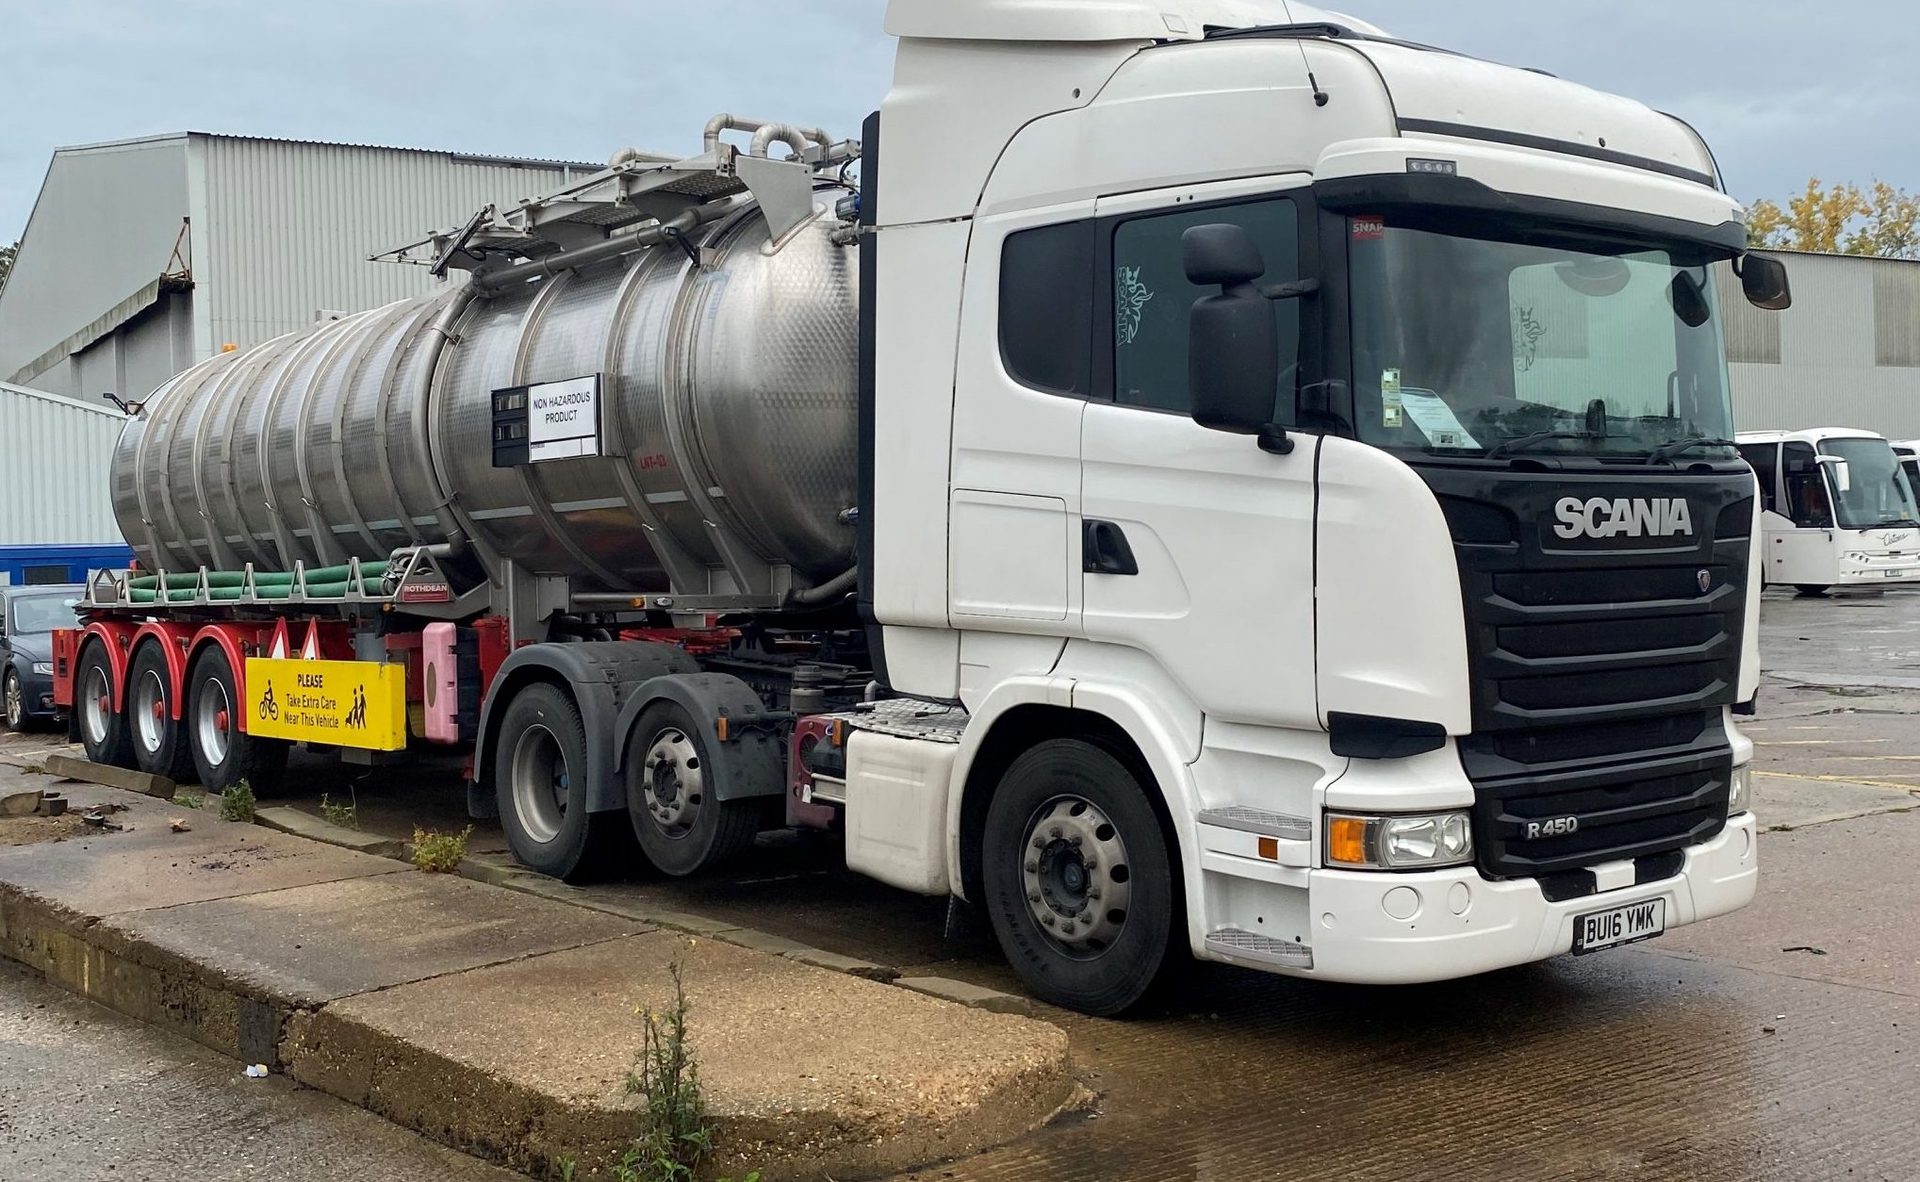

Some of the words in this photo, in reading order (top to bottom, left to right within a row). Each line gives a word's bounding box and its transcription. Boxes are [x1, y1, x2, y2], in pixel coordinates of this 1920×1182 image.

[1352, 222, 1384, 233] SNAP
[533, 399, 548, 410] NON
[549, 391, 591, 408] HAZARDOUS
[545, 409, 578, 424] PRODUCT
[1553, 497, 1693, 539] SCANIA
[404, 584, 447, 593] ROTHDEAN
[297, 674, 323, 689] PLEASE
[286, 693, 301, 708] Take
[302, 695, 319, 709] Extra
[320, 696, 337, 710] Care
[284, 711, 299, 725] Near
[300, 712, 314, 726] This
[315, 712, 339, 728] Vehicle
[1528, 822, 1540, 839] R
[1542, 816, 1578, 836] 450
[1586, 913, 1622, 944] BU16
[1627, 904, 1655, 933] YMK
